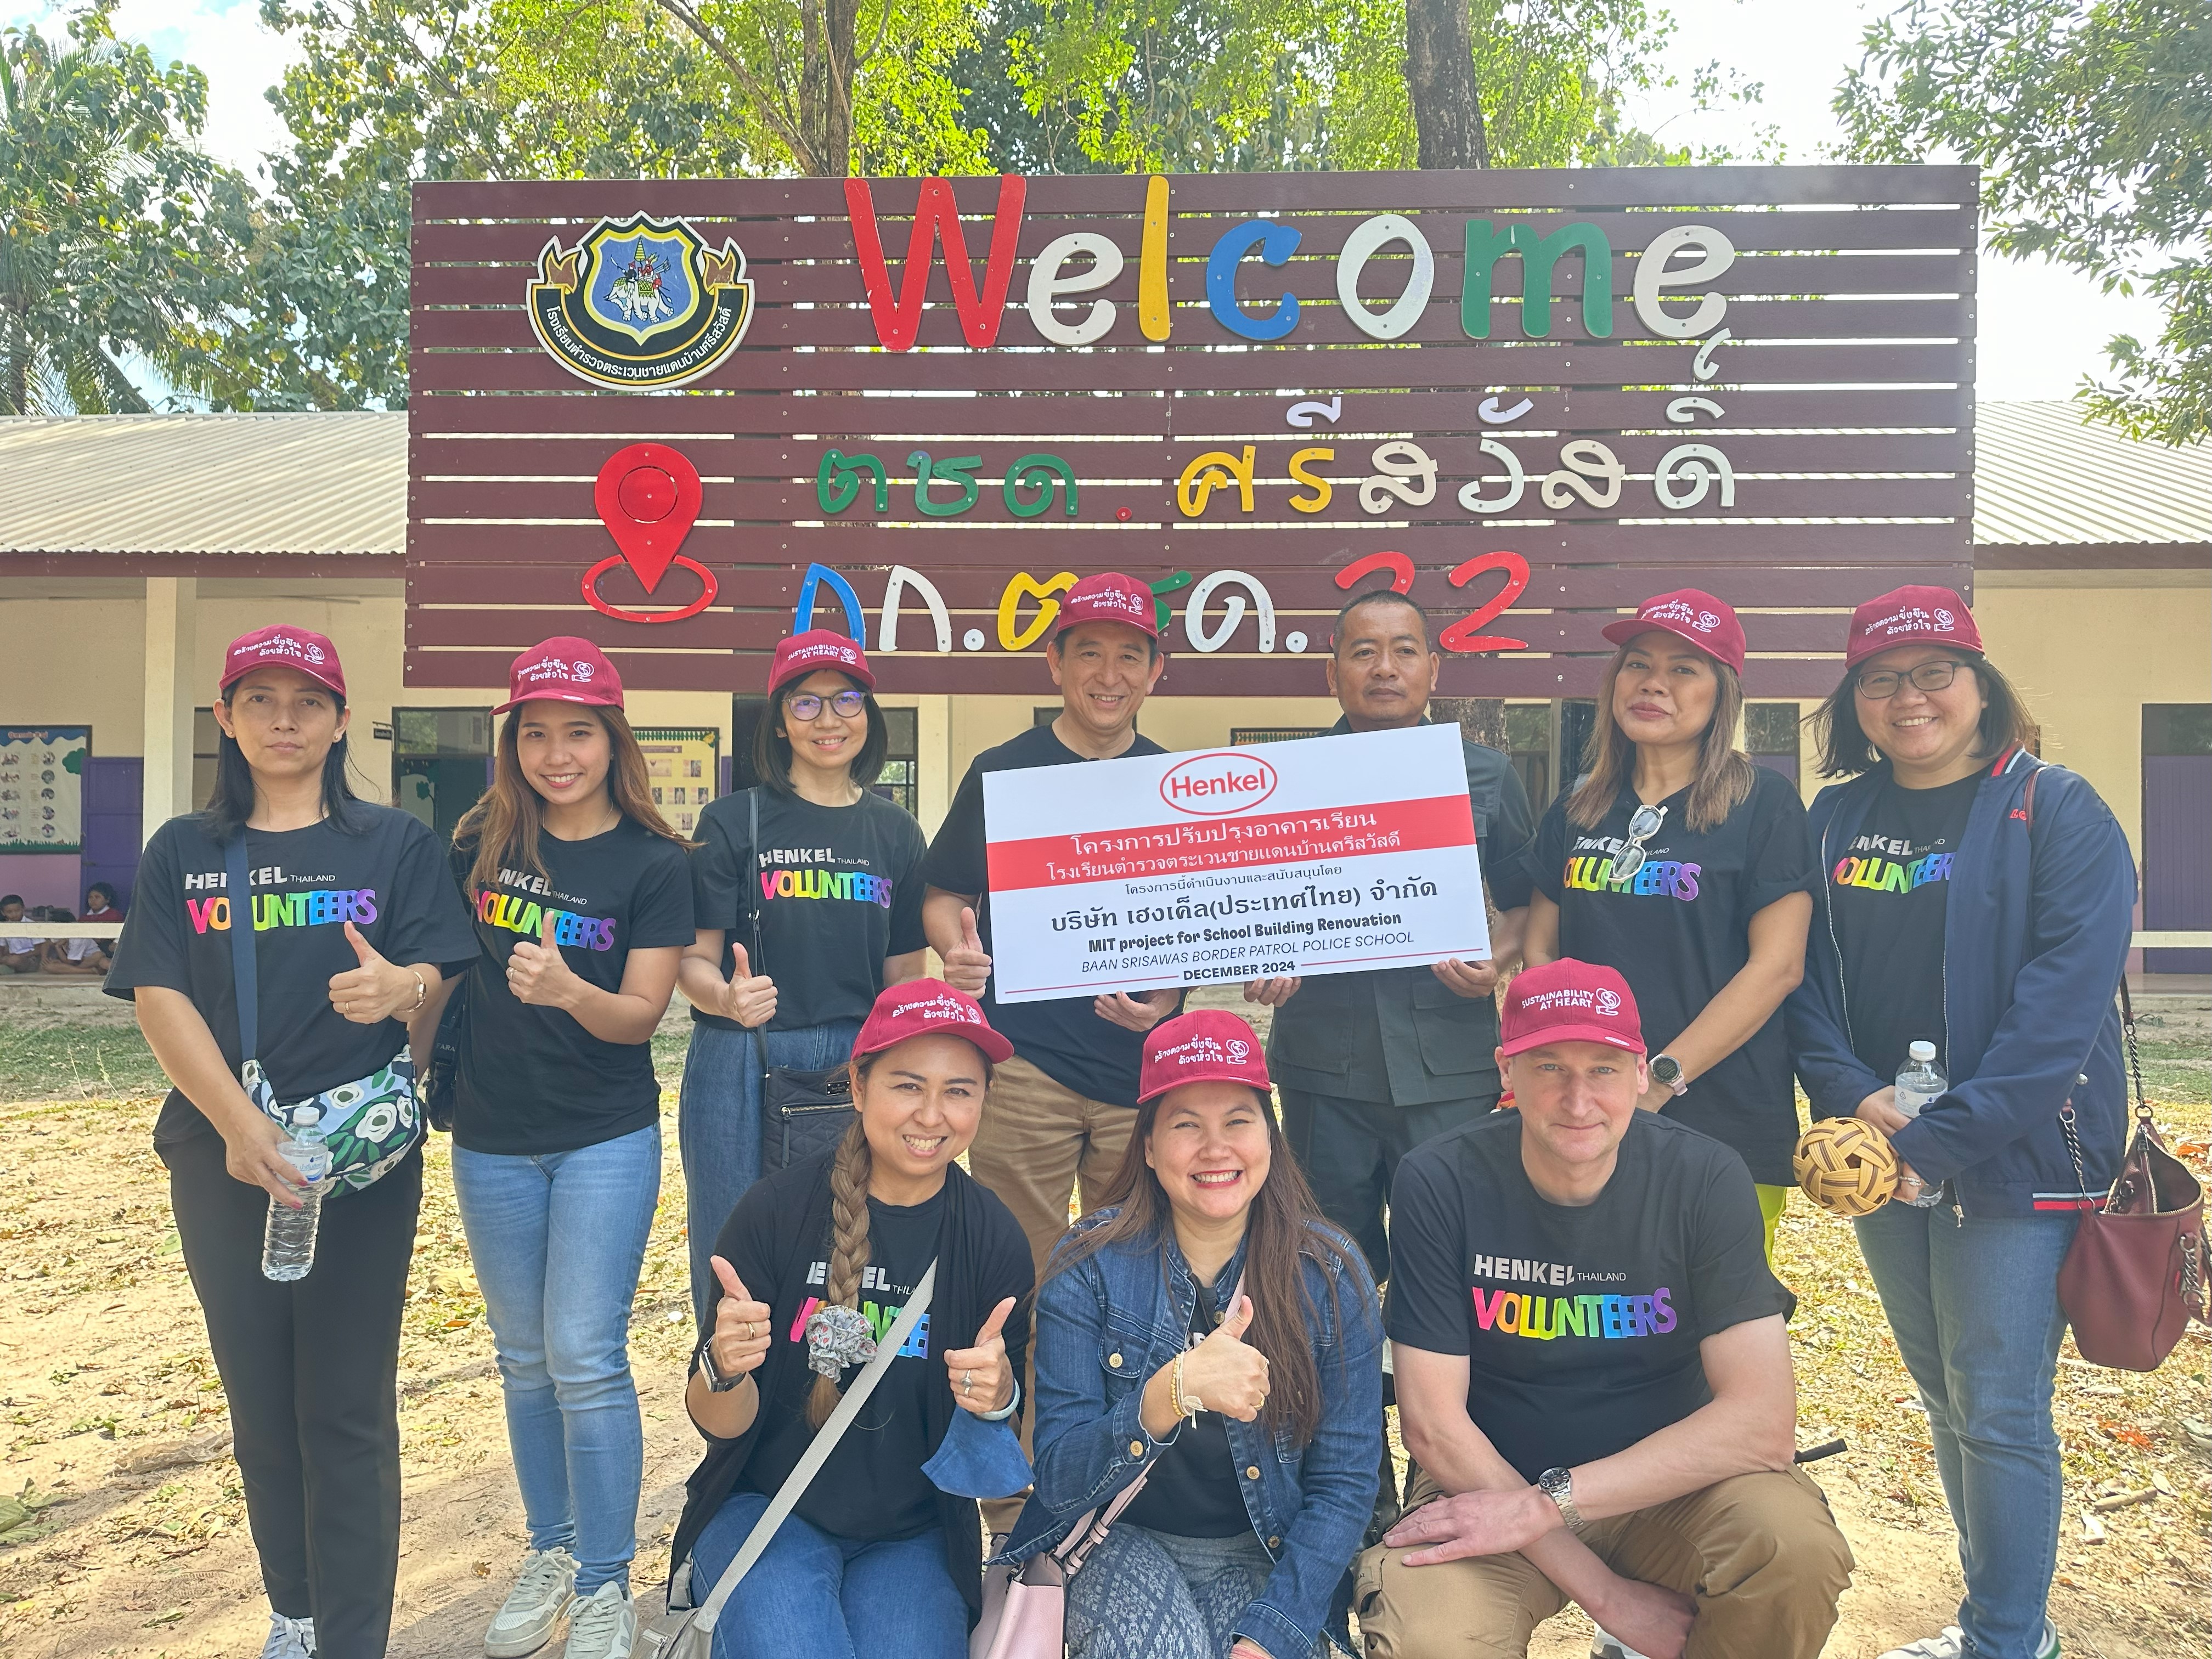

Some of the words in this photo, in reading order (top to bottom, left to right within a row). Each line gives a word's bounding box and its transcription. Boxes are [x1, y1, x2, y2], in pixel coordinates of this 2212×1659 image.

[844, 174, 1735, 352] Welcome
[1887, 619, 1931, 635] ด้วยหัวใจ
[787, 644, 839, 661] SUSTAINABILITY
[812, 649, 838, 657] HEART
[1171, 768, 1266, 798] Henkel
[1070, 811, 1377, 855] โครงการปรับปรุงอาคารเรียน
[1572, 836, 1628, 854] ENKE
[1848, 834, 1912, 855] ENKEL
[759, 848, 836, 867] HENKEL
[837, 857, 870, 866] THAILAND
[290, 874, 336, 883] THAILAND
[760, 869, 893, 909] VOLUNTEERS
[1125, 865, 1342, 895] โครงการนี้ดำเนินงานและสนับสนุนโดย
[187, 889, 377, 934] VOUNTEERS
[1052, 906, 1117, 931] บริษัท
[1370, 876, 1437, 900] จำกัด
[1088, 938, 1116, 952] MIT
[1119, 933, 1174, 952] project
[1177, 931, 1200, 944] for
[1204, 925, 1251, 941] School
[1255, 921, 1314, 937] Building
[1317, 913, 1401, 931] Renovation
[1082, 959, 1118, 972] BAAN
[1122, 952, 1188, 969] SRISAWAS
[1192, 947, 1245, 962] BORDER
[1249, 942, 1299, 957] PATROL
[1303, 937, 1351, 952] POLICE
[1355, 932, 1414, 947] SCHOOL
[1184, 964, 1259, 980] DECEMBER
[1262, 961, 1295, 974] 2024
[1522, 989, 1594, 1009] SUSTAINABILITY
[1539, 1000, 1552, 1011] AT
[1555, 997, 1593, 1008] HEART
[1178, 1049, 1223, 1065] ด้วยหัวใจ
[1474, 1254, 1574, 1286] HENKEL
[1577, 1272, 1626, 1282] THAILAND
[1472, 1286, 1678, 1340] VOLUNTEERS
